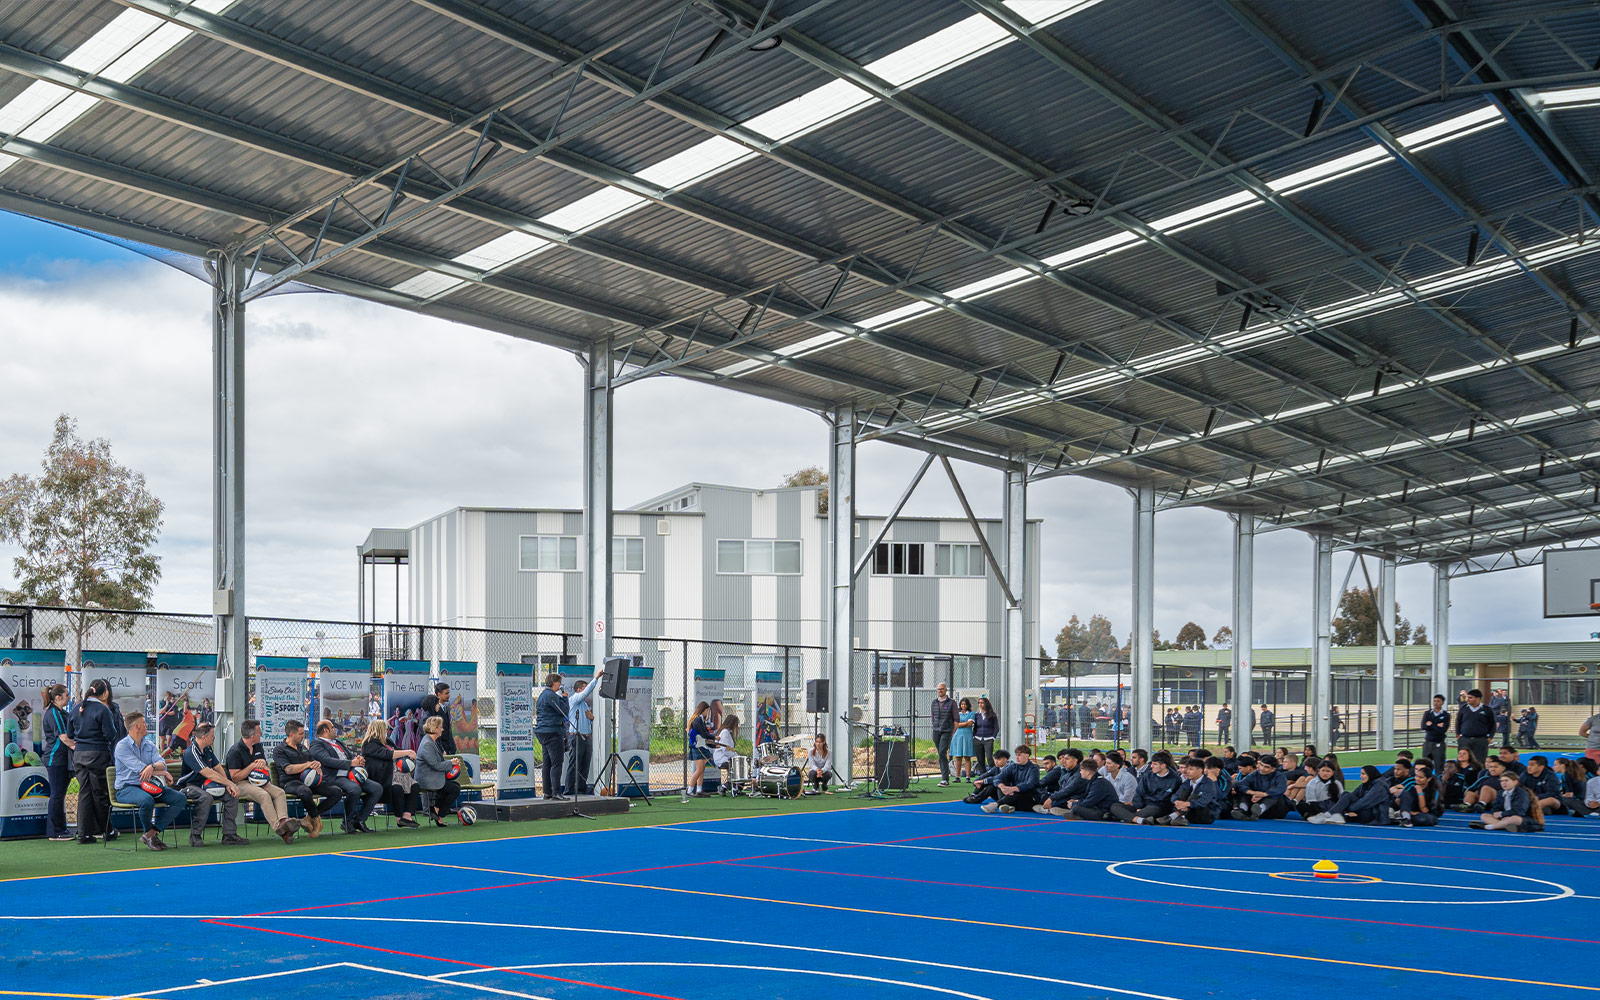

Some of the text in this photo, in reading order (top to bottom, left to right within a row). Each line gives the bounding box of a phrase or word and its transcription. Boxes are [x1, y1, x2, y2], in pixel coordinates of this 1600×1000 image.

[12, 674, 57, 688] Science
[102, 676, 131, 688] CAL
[173, 677, 203, 691] Sport
[330, 680, 363, 690] VCE VM
[390, 681, 425, 692] The Arts
[450, 680, 471, 691] LOTE
